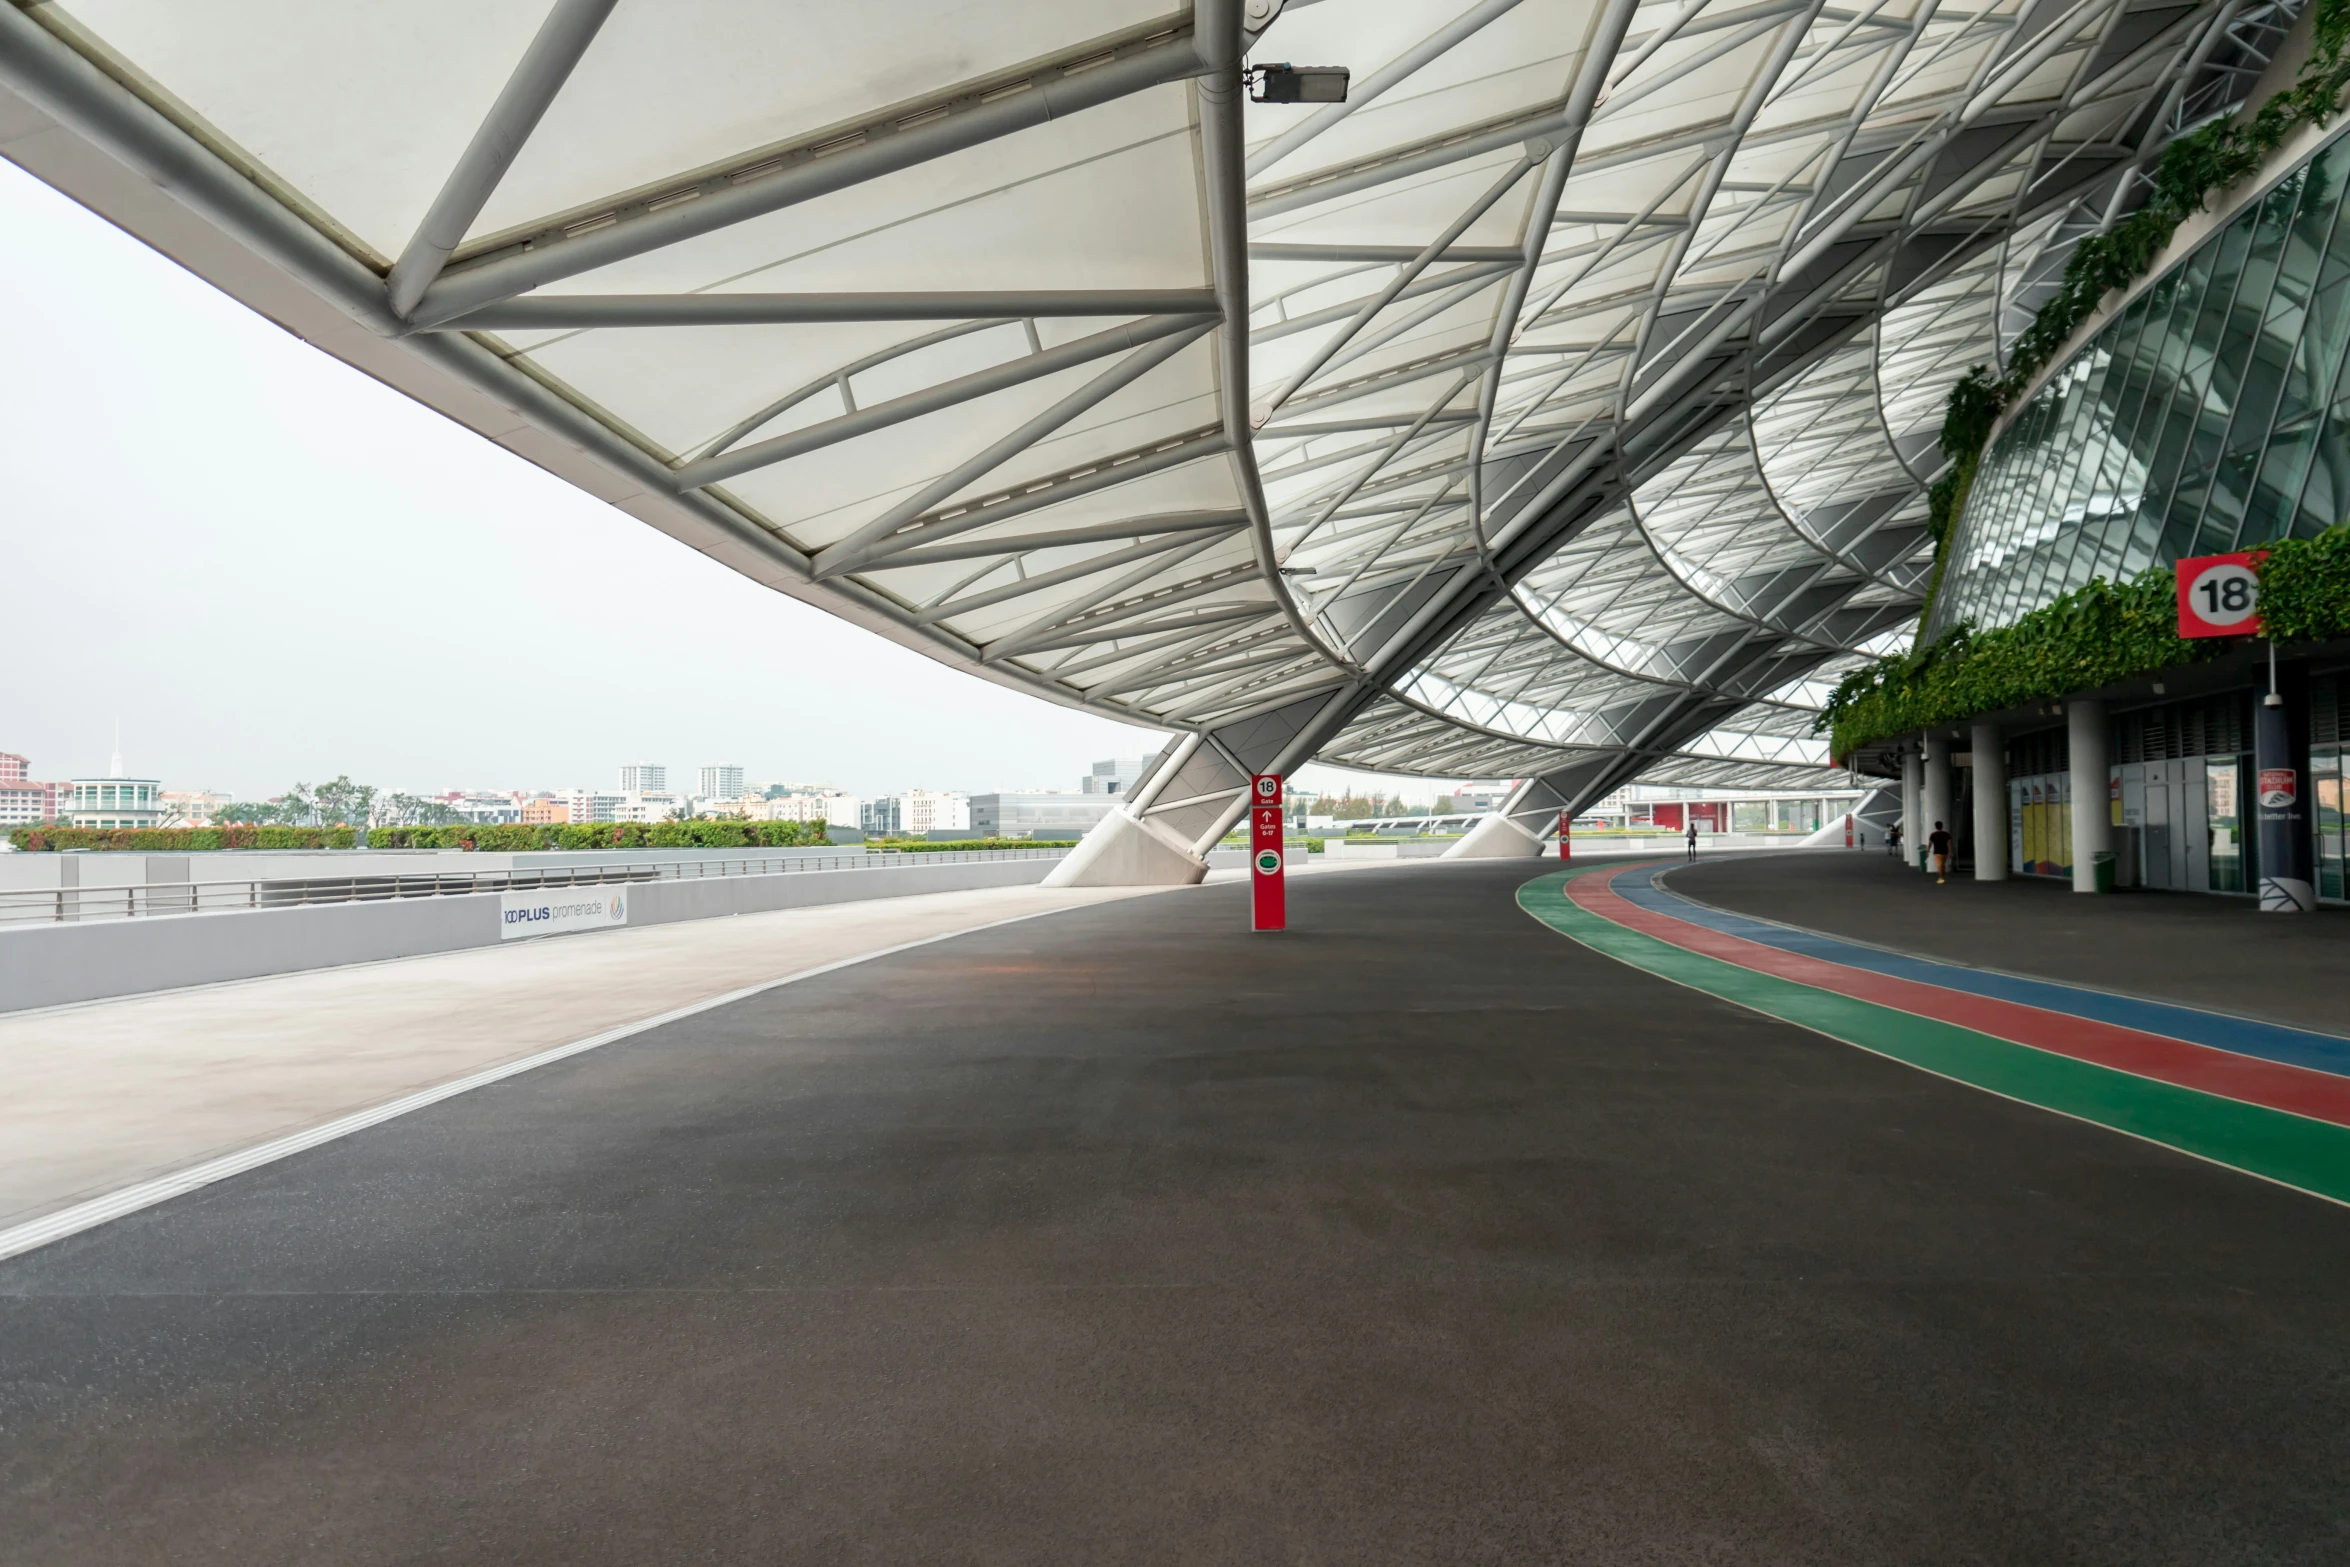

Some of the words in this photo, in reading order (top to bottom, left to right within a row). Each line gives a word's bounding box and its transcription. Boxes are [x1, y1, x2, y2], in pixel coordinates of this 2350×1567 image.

[2200, 577, 2250, 612] 18
[1259, 781, 1274, 792] 18
[552, 900, 602, 922] promenade
